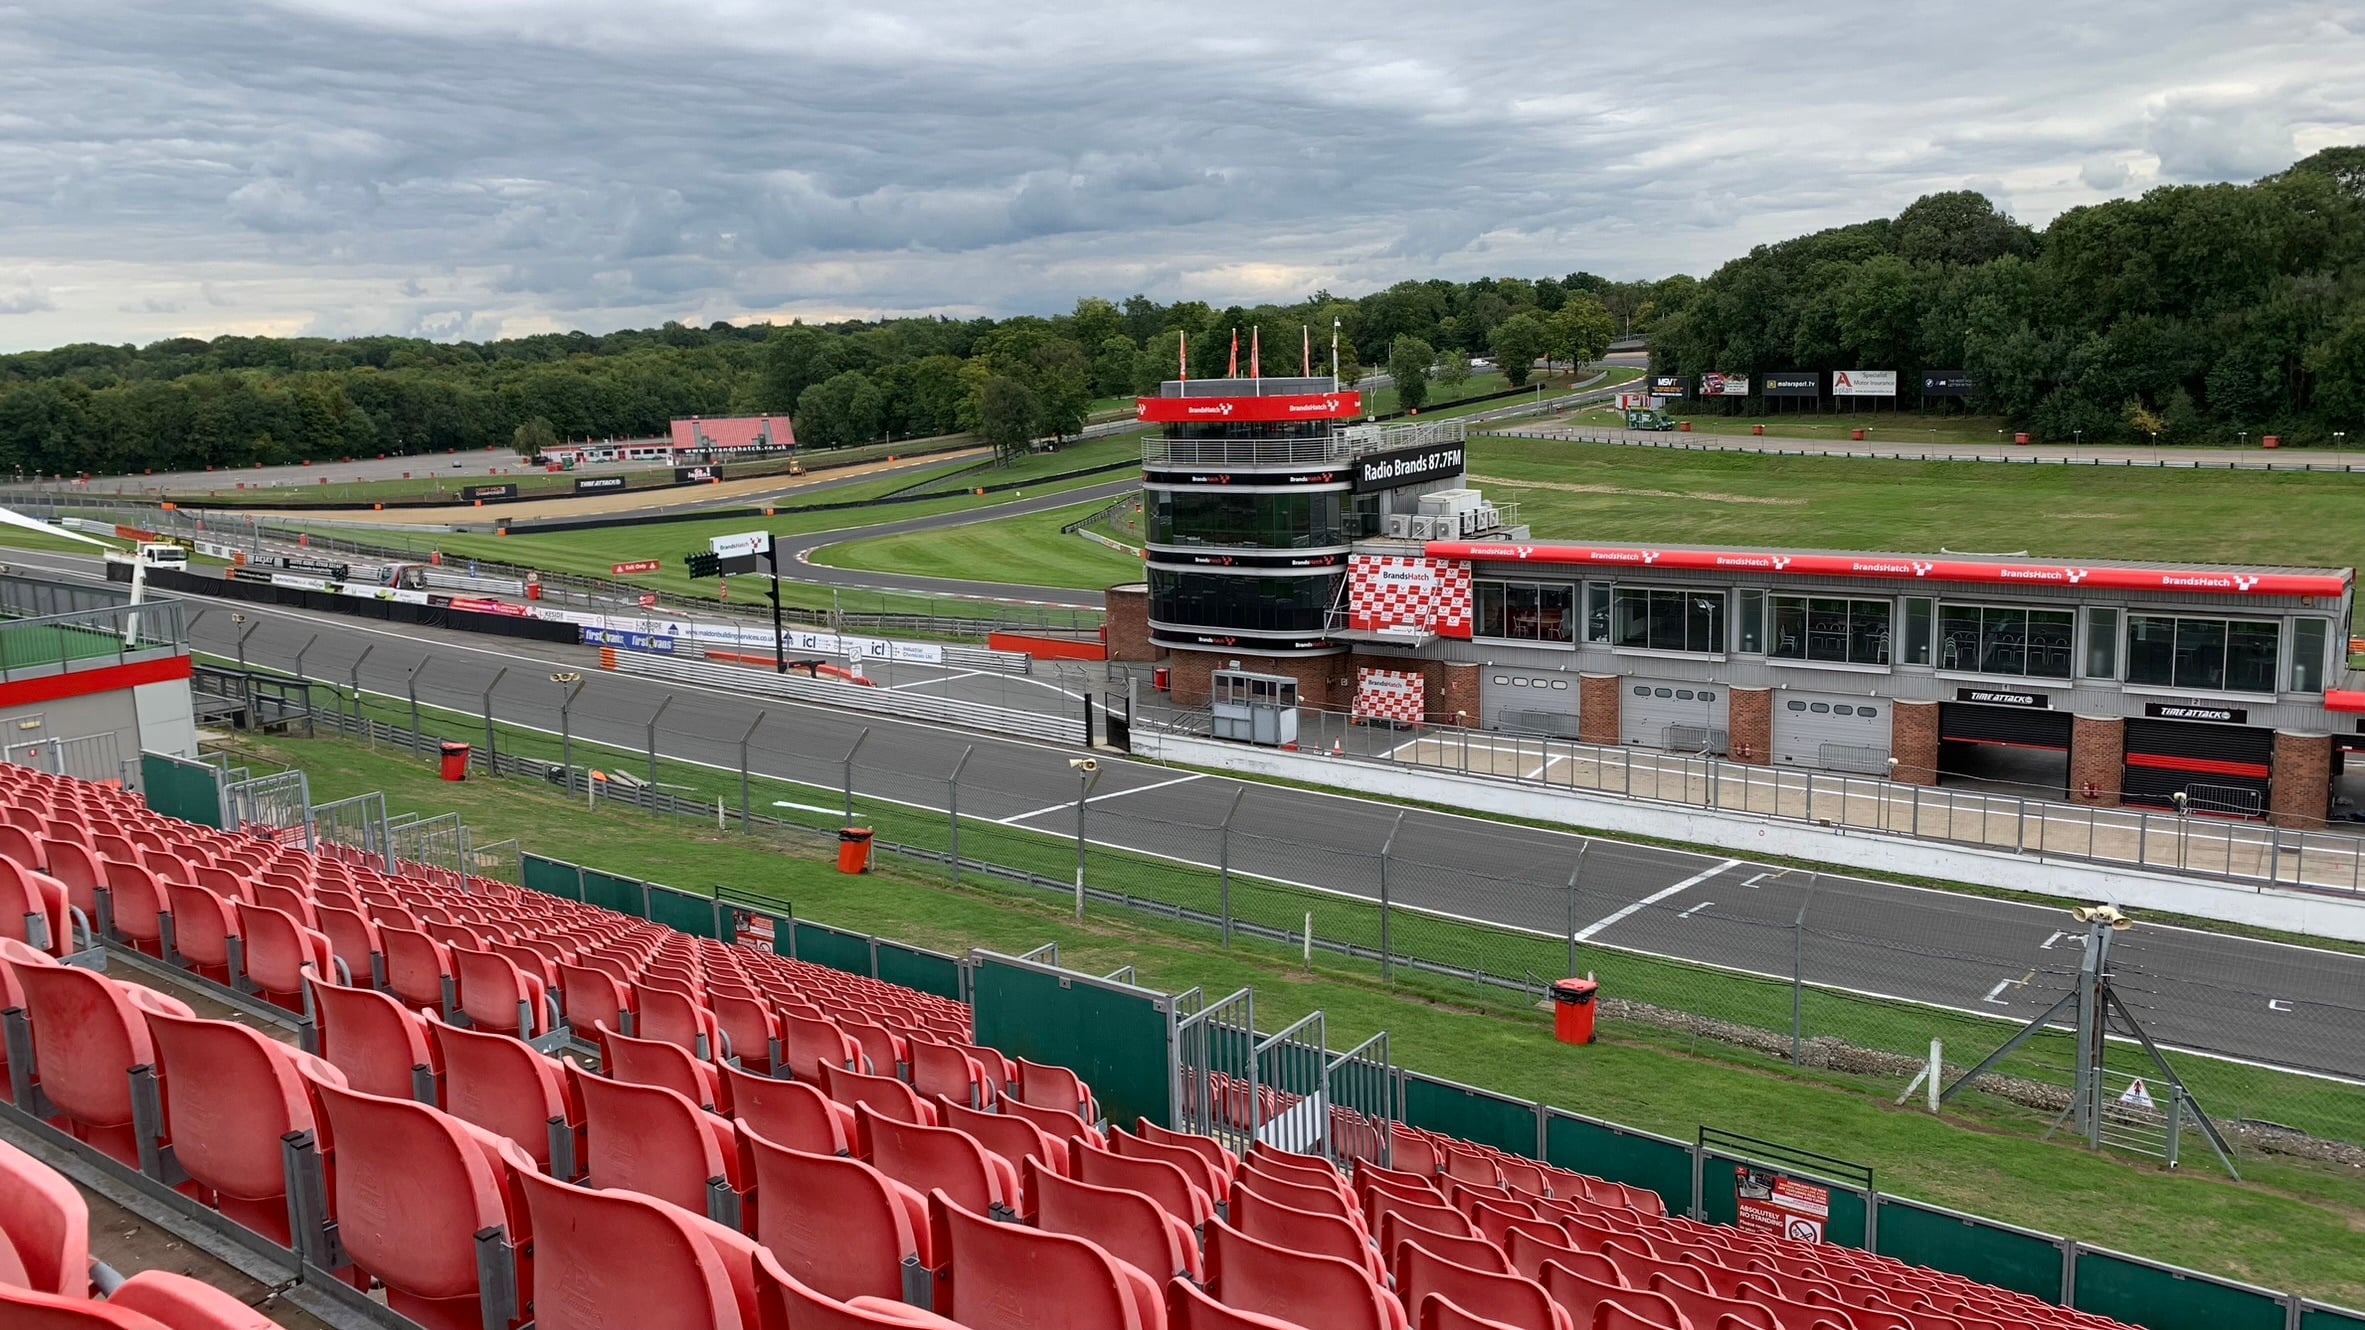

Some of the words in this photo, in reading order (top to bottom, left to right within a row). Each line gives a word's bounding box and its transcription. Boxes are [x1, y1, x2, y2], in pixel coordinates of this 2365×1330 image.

[1777, 380, 1815, 388] motorsport.tv
[1188, 406, 1221, 414] BrandsHatch
[1289, 403, 1328, 412] BrandsHatch
[684, 444, 787, 454] www.brandshatch.co.uk
[1364, 461, 1393, 481] Radio
[1394, 454, 1427, 476] Brands
[1428, 449, 1461, 470] 87.7FM
[1470, 547, 1515, 556] BrandsHatch
[1590, 551, 1639, 561] BrandsHatch
[1716, 556, 1769, 567] BrandsHatch
[1852, 562, 1910, 573] BrandsHatch
[1382, 570, 1430, 582] BrandsHatch
[2000, 568, 2062, 580] BrandsHatch
[2162, 575, 2231, 587] BrandsHatch
[802, 634, 816, 648] icl
[871, 641, 885, 656] icl
[1367, 679, 1402, 689] BrandsHatch
[1971, 692, 1994, 701] TIME
[1992, 693, 2026, 704] ATTACK
[2160, 707, 2187, 716] TIME
[2184, 709, 2222, 719] ATTACK
[1739, 1204, 1780, 1220] ABSOLUTELY
[1739, 1210, 1750, 1218] NO
[1750, 1212, 1784, 1228] STANDING
